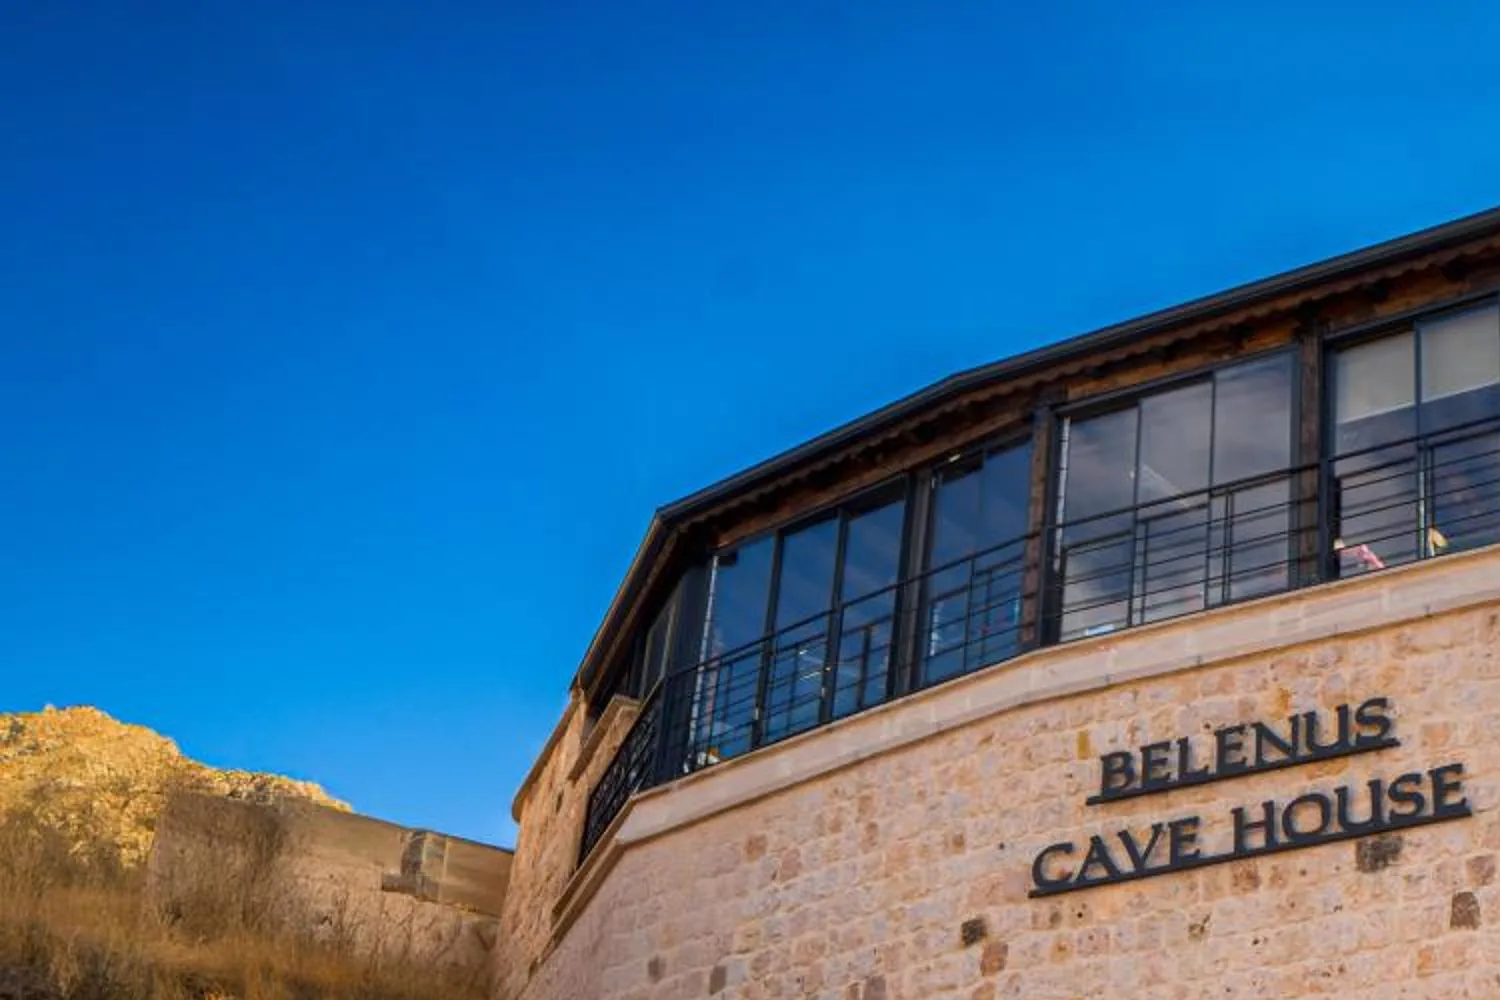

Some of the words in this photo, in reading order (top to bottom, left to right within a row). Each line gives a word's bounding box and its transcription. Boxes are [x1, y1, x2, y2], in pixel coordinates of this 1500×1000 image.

[1099, 697, 1394, 794] BELENUS
[1031, 815, 1202, 888] CAVE
[1231, 763, 1467, 856] HOUSE
